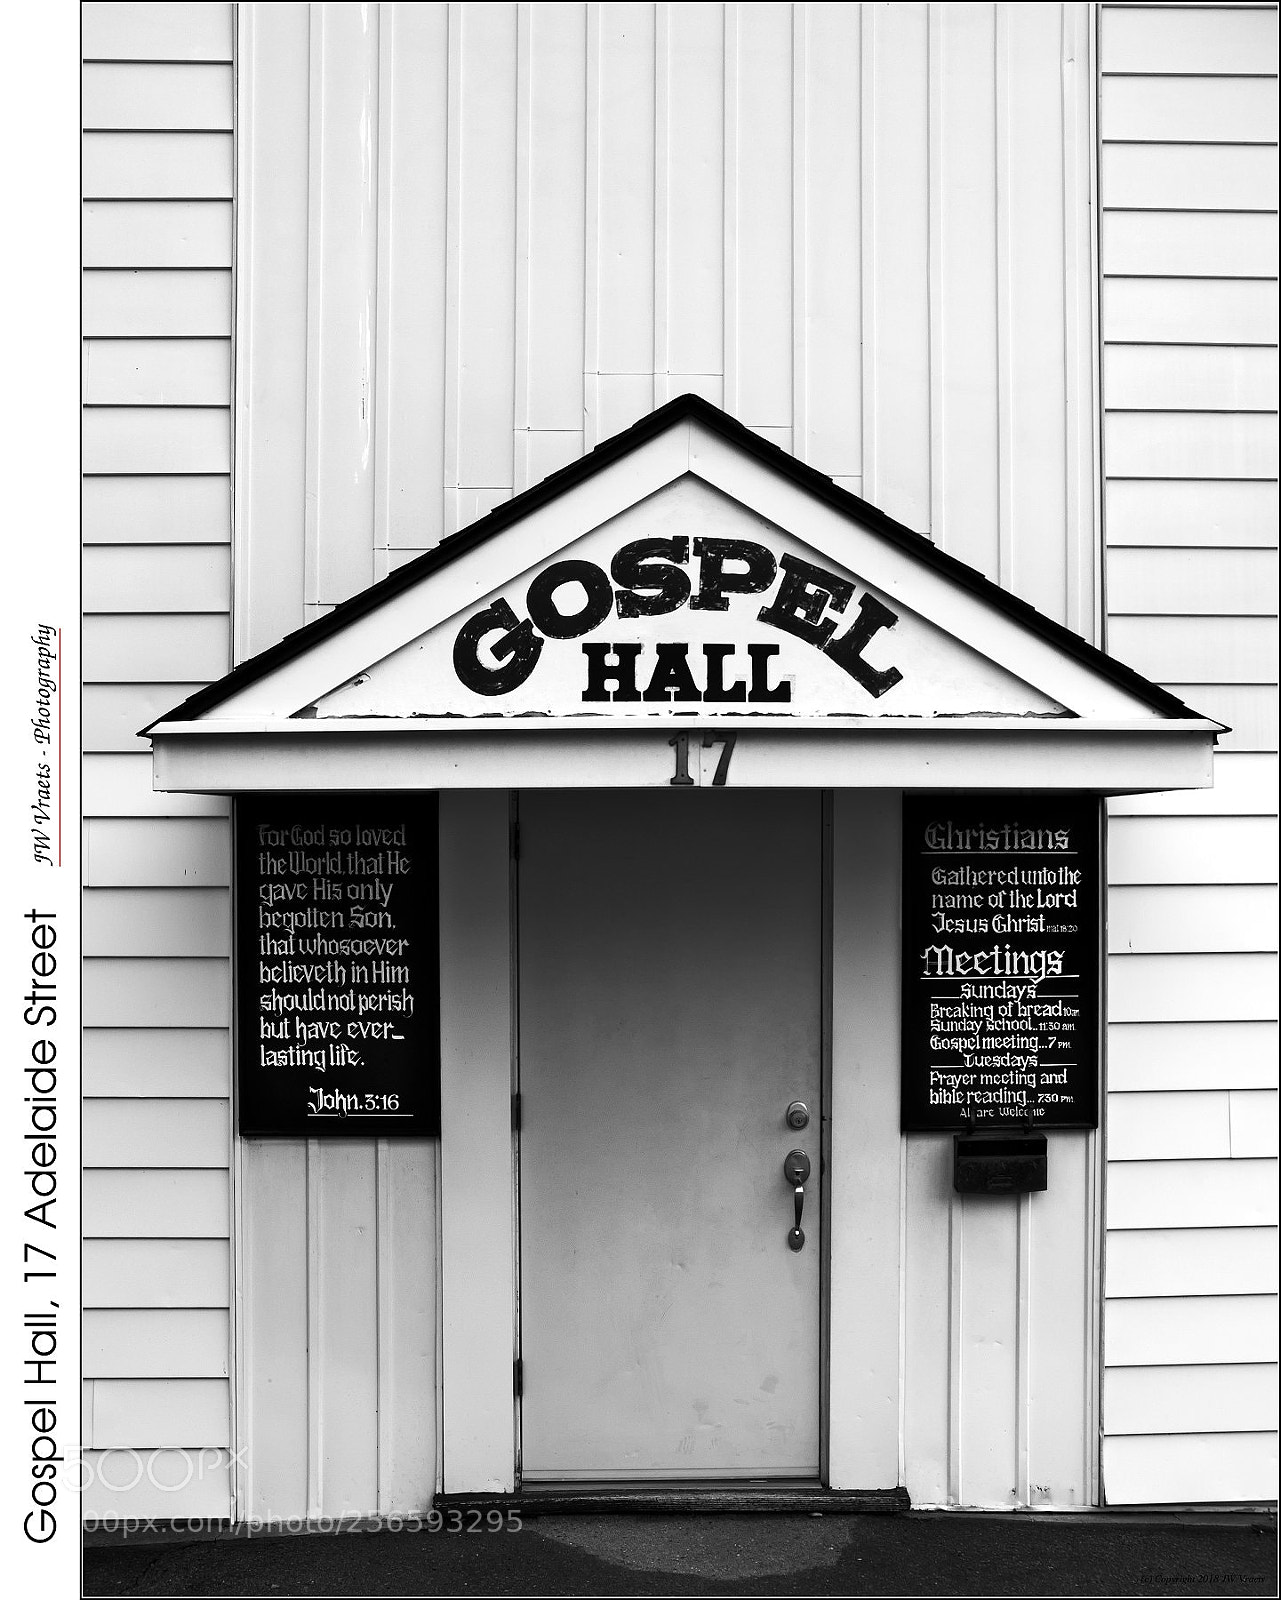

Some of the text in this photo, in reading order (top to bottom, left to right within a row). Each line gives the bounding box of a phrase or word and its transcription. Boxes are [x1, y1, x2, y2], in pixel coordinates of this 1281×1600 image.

[453, 536, 904, 698] GOSPEL
[581, 642, 791, 702] HALL
[669, 730, 737, 786] 17
[258, 825, 406, 846] For God so loved
[925, 821, 1070, 850] Christians
[259, 852, 286, 875] the
[347, 852, 384, 875] that
[388, 852, 409, 874] He
[932, 866, 1081, 888] Gathered unto the
[260, 878, 393, 907] gave His only
[933, 888, 1077, 908] name of the Lord
[259, 905, 344, 934] begotten
[932, 912, 988, 933] Jesus
[992, 914, 1045, 933] Christ
[259, 933, 409, 956] that whosoever
[260, 961, 409, 985] believeth in Him
[920, 944, 1066, 984] Meetings
[260, 988, 414, 1017] should not perish
[960, 981, 1038, 1003] Sundays
[931, 1002, 993, 1020] Breaking
[999, 1001, 1013, 1017] of
[1018, 1000, 1062, 1017] bread
[260, 1016, 290, 1039] but
[296, 1016, 342, 1047] have
[931, 1019, 983, 1035] Sunday
[930, 1034, 979, 1052] Gospel
[261, 1044, 364, 1072] lasting life.
[963, 1052, 1038, 1071] Tuesdays
[930, 1068, 1067, 1089] Prayer meeting and
[930, 1088, 964, 1104] bible
[977, 1109, 994, 1117] are
